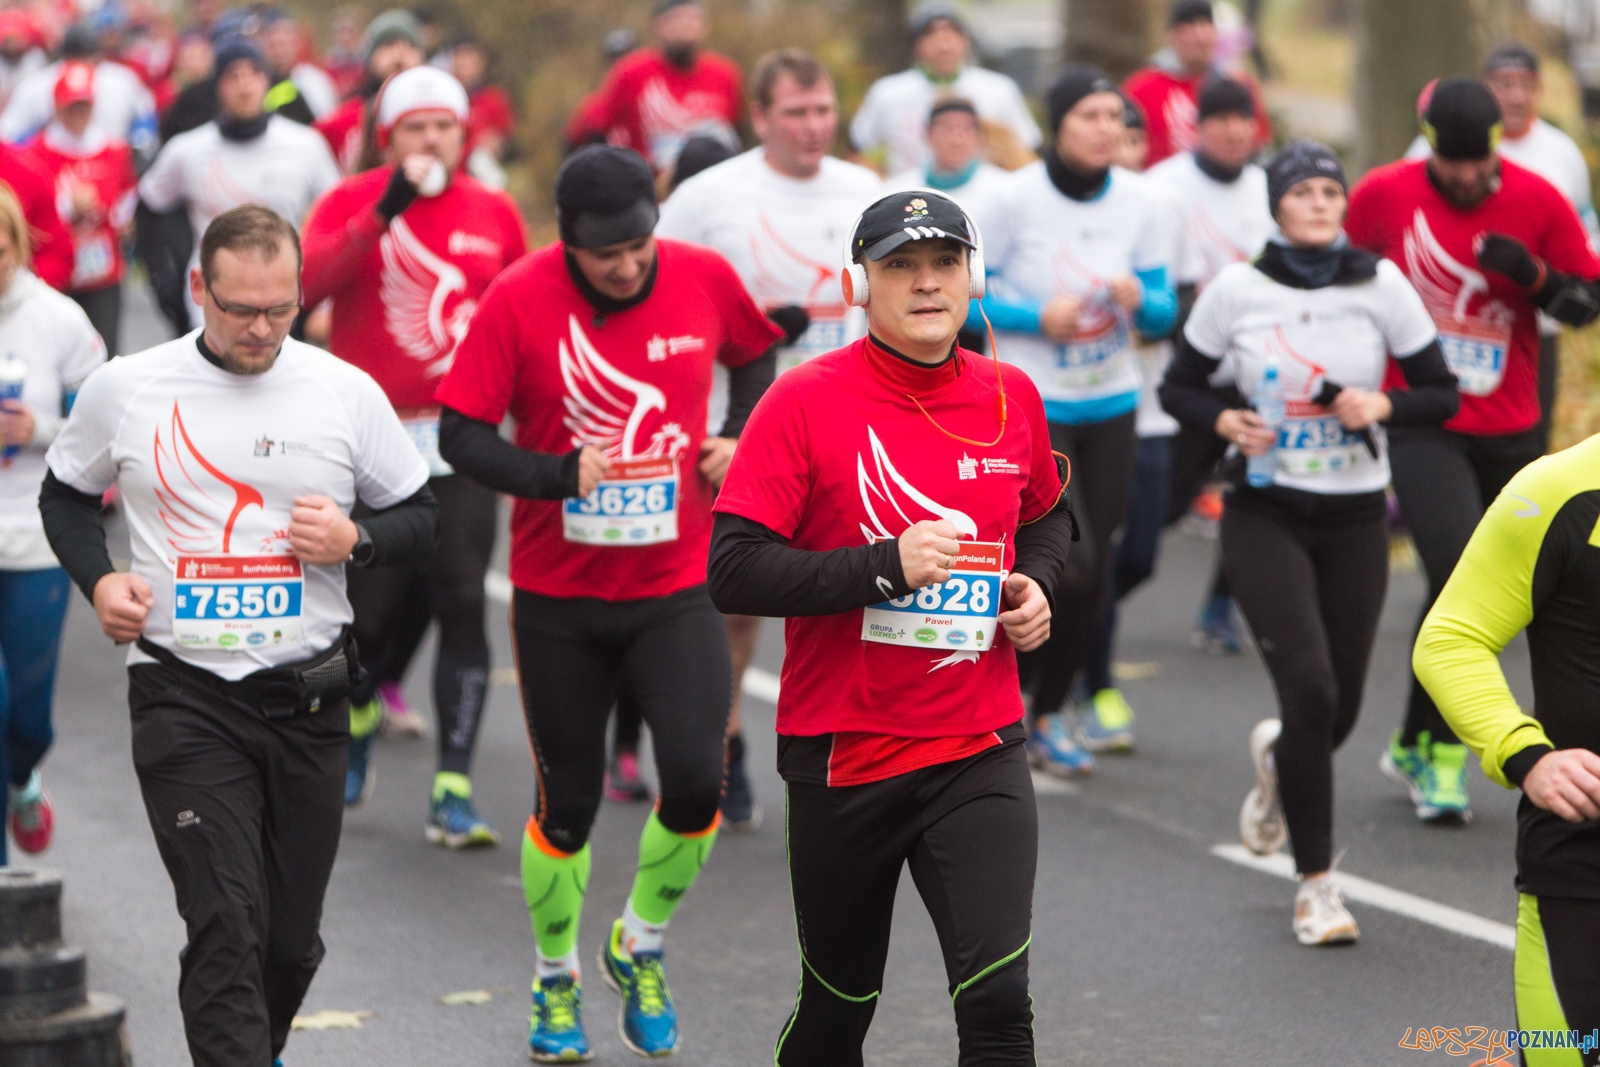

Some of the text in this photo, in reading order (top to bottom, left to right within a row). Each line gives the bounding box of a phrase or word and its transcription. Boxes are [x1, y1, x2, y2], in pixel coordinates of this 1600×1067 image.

[981, 457, 991, 473] 1
[580, 484, 666, 514] 3626
[954, 554, 997, 565] unPoland.org
[177, 595, 187, 608] E
[191, 585, 289, 618] 7550
[925, 617, 953, 625] Paweł
[869, 629, 897, 640] LUXMED
[870, 624, 893, 633] GRUPA
